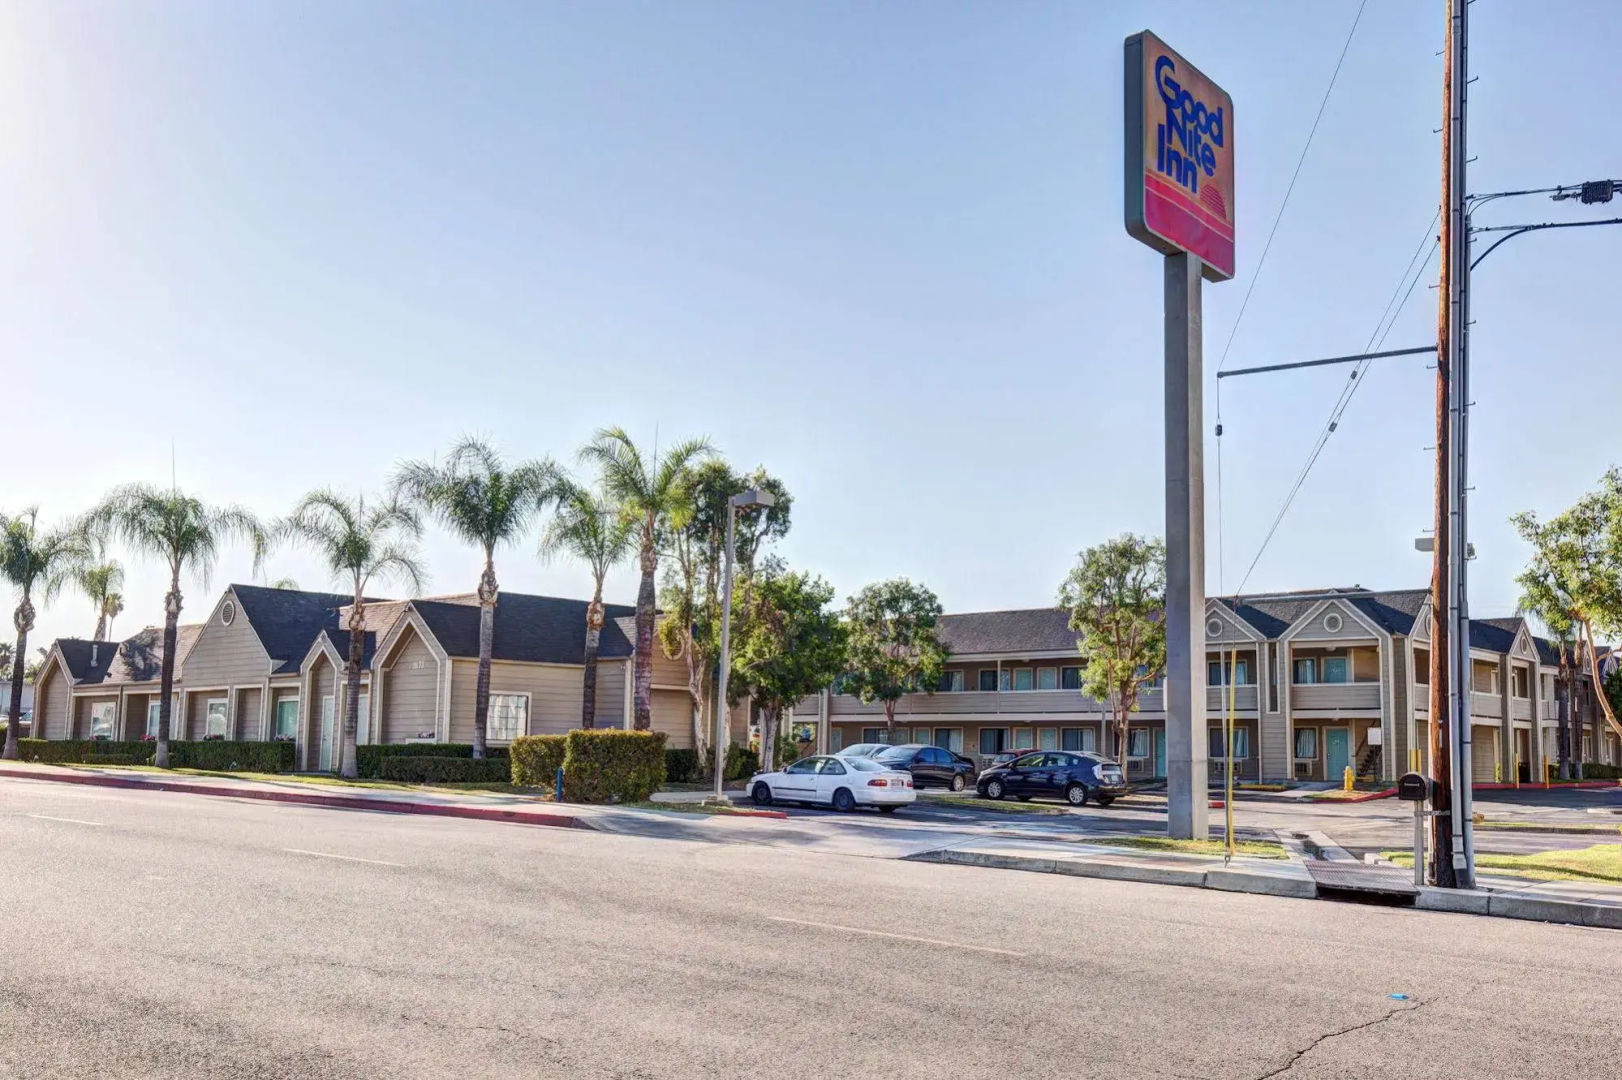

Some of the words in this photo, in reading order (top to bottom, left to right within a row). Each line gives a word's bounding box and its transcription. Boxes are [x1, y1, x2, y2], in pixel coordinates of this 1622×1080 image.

[1155, 55, 1224, 148] Good
[1157, 123, 1197, 194] Inn
[1165, 103, 1216, 177] Nite
